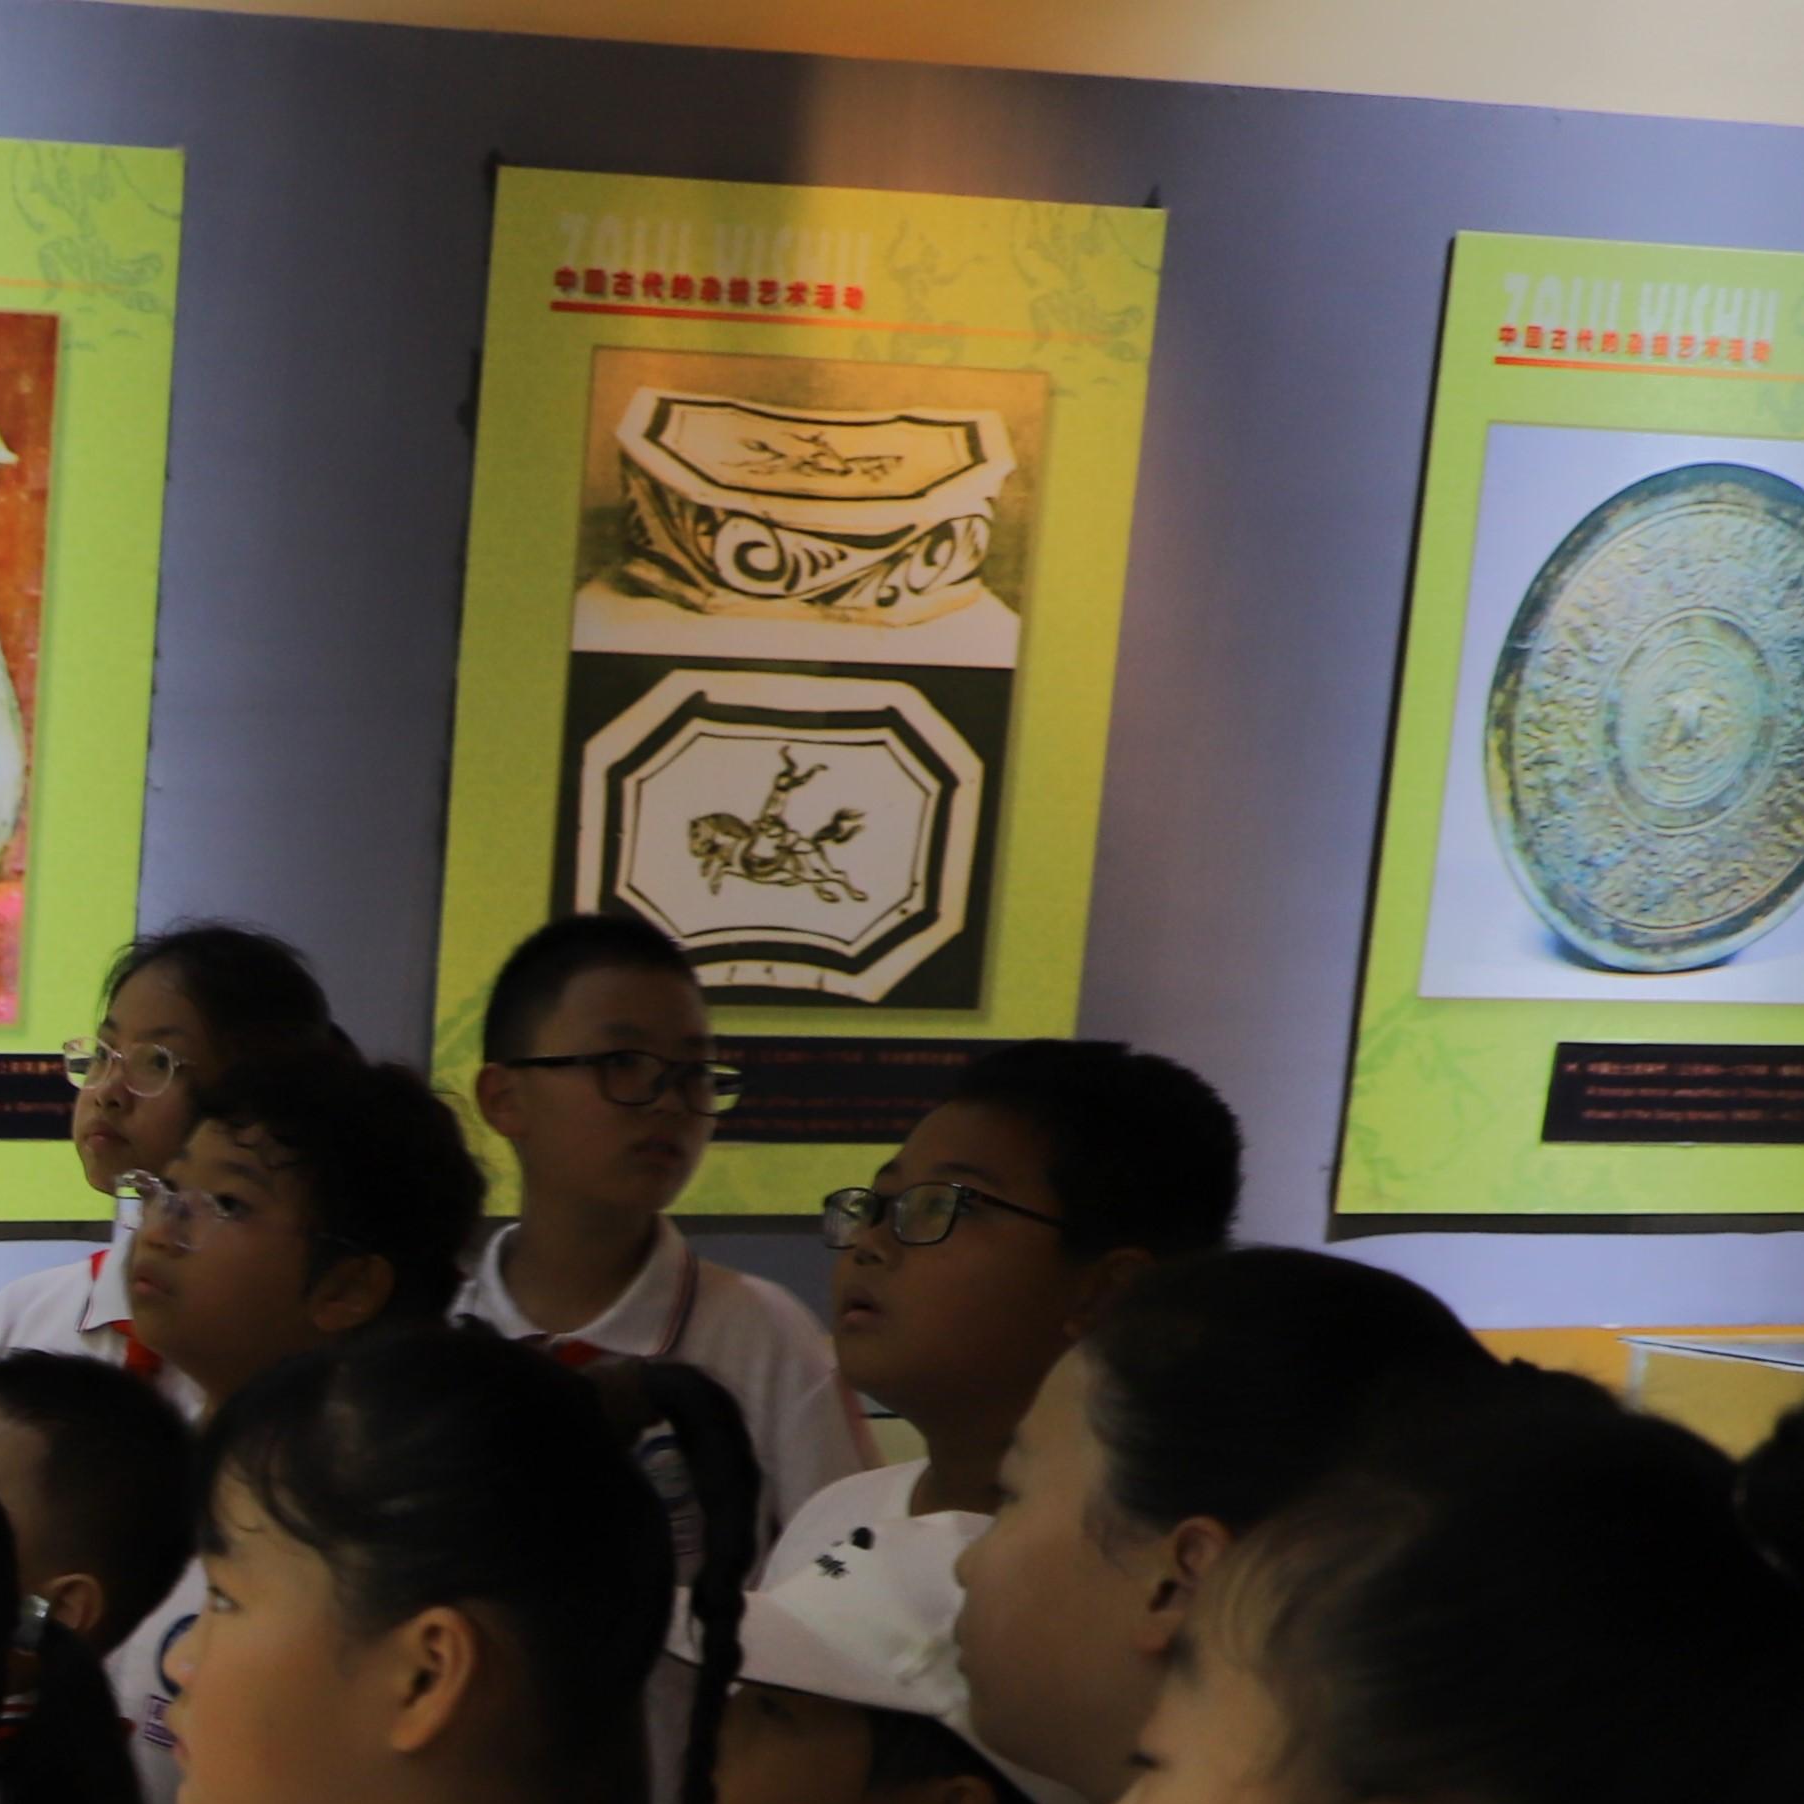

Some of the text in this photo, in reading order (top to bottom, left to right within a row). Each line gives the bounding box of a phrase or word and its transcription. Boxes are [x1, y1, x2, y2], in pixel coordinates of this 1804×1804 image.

[554, 269, 864, 310] 中国古代的杂技艺术活动
